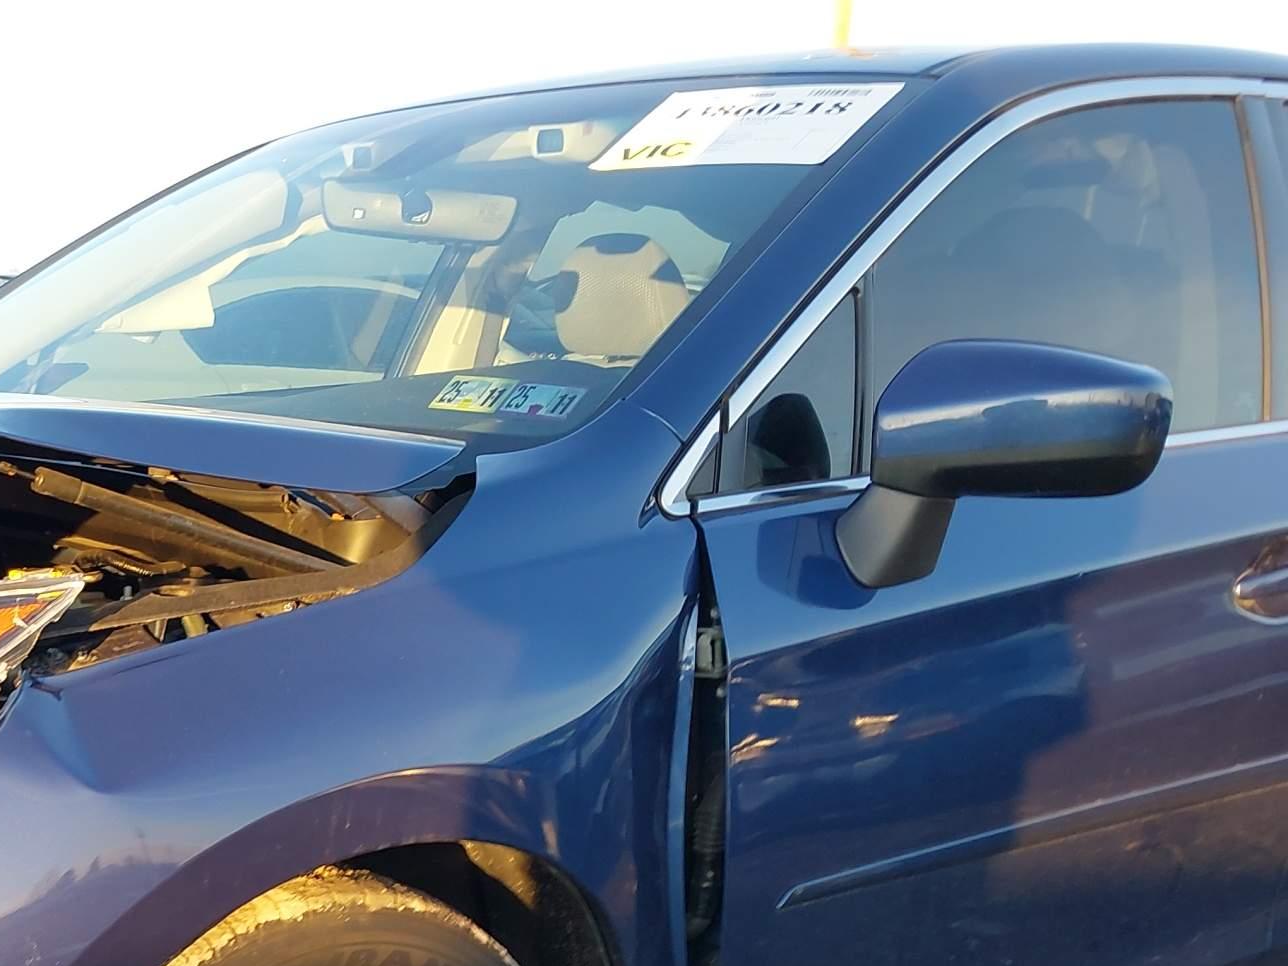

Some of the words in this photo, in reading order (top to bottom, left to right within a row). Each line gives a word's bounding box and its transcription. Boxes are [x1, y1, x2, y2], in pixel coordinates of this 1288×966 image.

[621, 141, 692, 162] VIC
[437, 379, 469, 404] 25
[479, 386, 508, 409] 11
[504, 384, 537, 410] 25
[549, 393, 579, 415] 11
